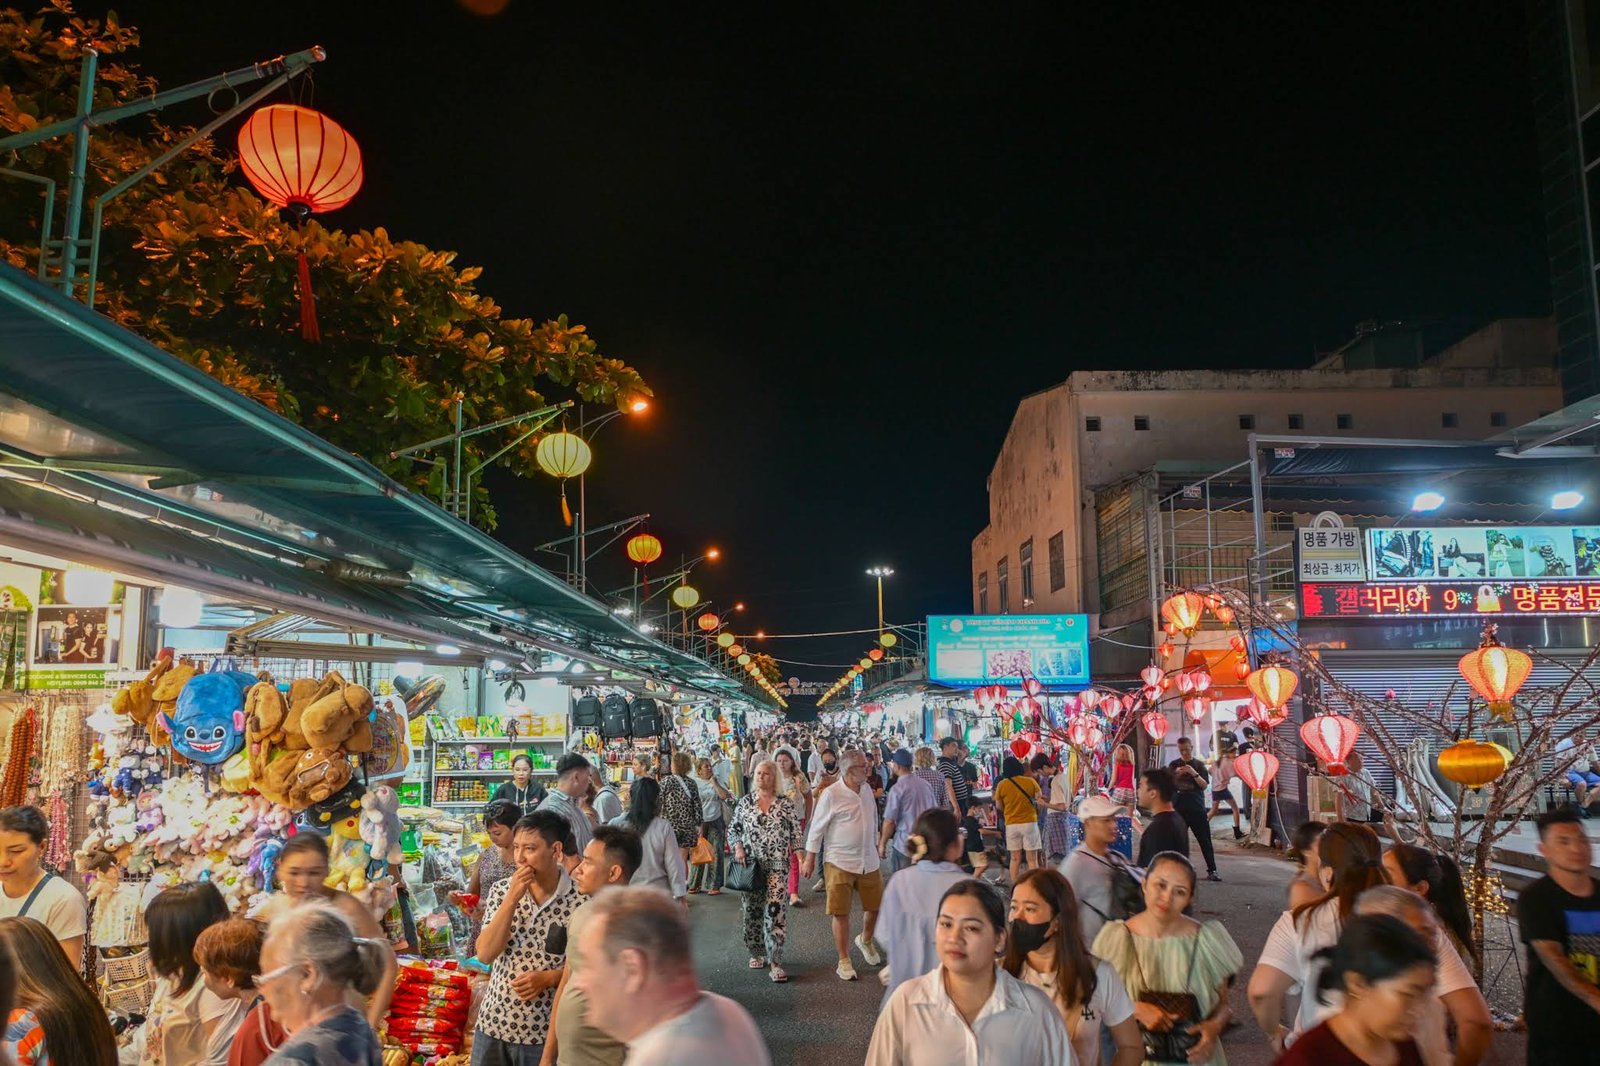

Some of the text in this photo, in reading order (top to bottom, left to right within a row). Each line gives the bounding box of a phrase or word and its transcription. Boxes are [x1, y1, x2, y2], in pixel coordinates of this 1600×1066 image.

[1303, 531, 1356, 548] 명품 가방
[1303, 562, 1361, 576] 최상급·최저가
